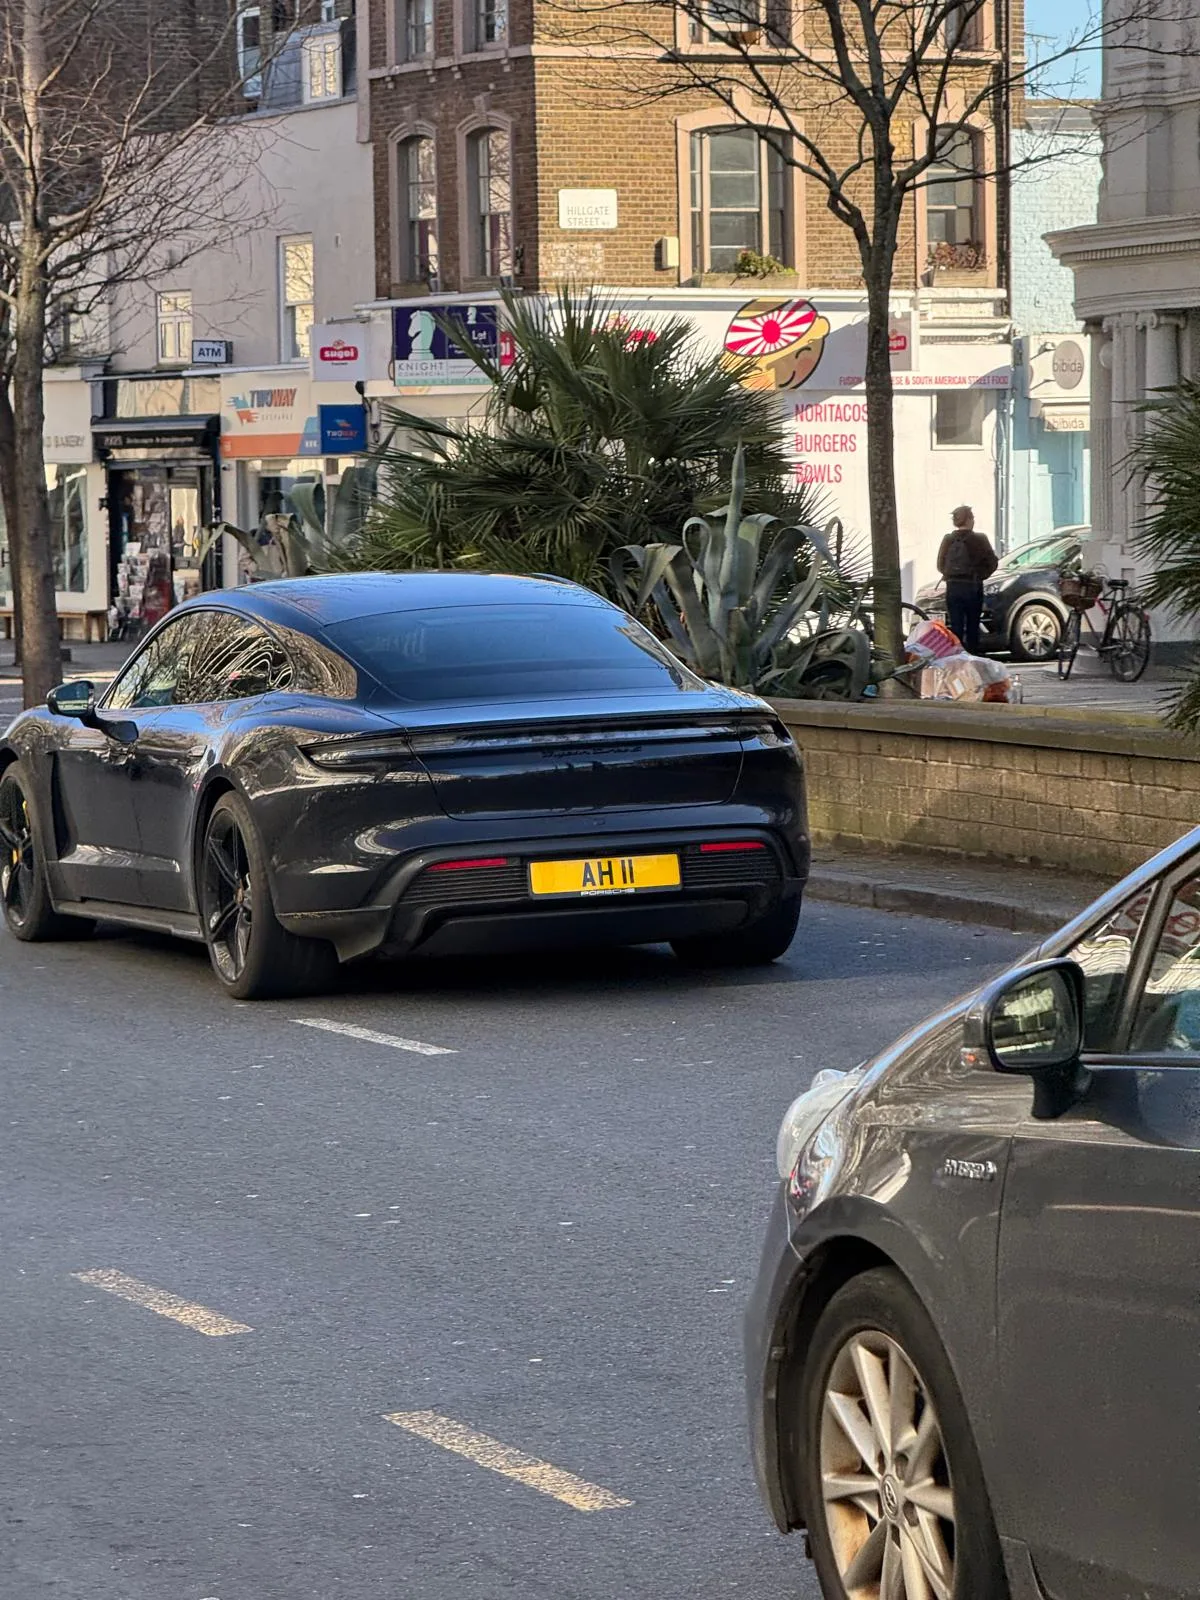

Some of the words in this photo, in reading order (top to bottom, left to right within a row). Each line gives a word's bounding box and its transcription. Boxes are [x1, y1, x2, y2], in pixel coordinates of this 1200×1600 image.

[567, 206, 610, 216] HILLGATE
[567, 217, 600, 227] STREET
[198, 347, 222, 358] ATM
[398, 361, 444, 371] KNIGHT
[1053, 359, 1082, 373] bibida
[911, 375, 933, 385] SOUTH
[934, 375, 967, 385] AMERICAN
[991, 375, 1009, 385] FOOD
[795, 403, 868, 422] NORITACOS
[795, 434, 857, 452] BURGERS
[581, 860, 614, 887] AH
